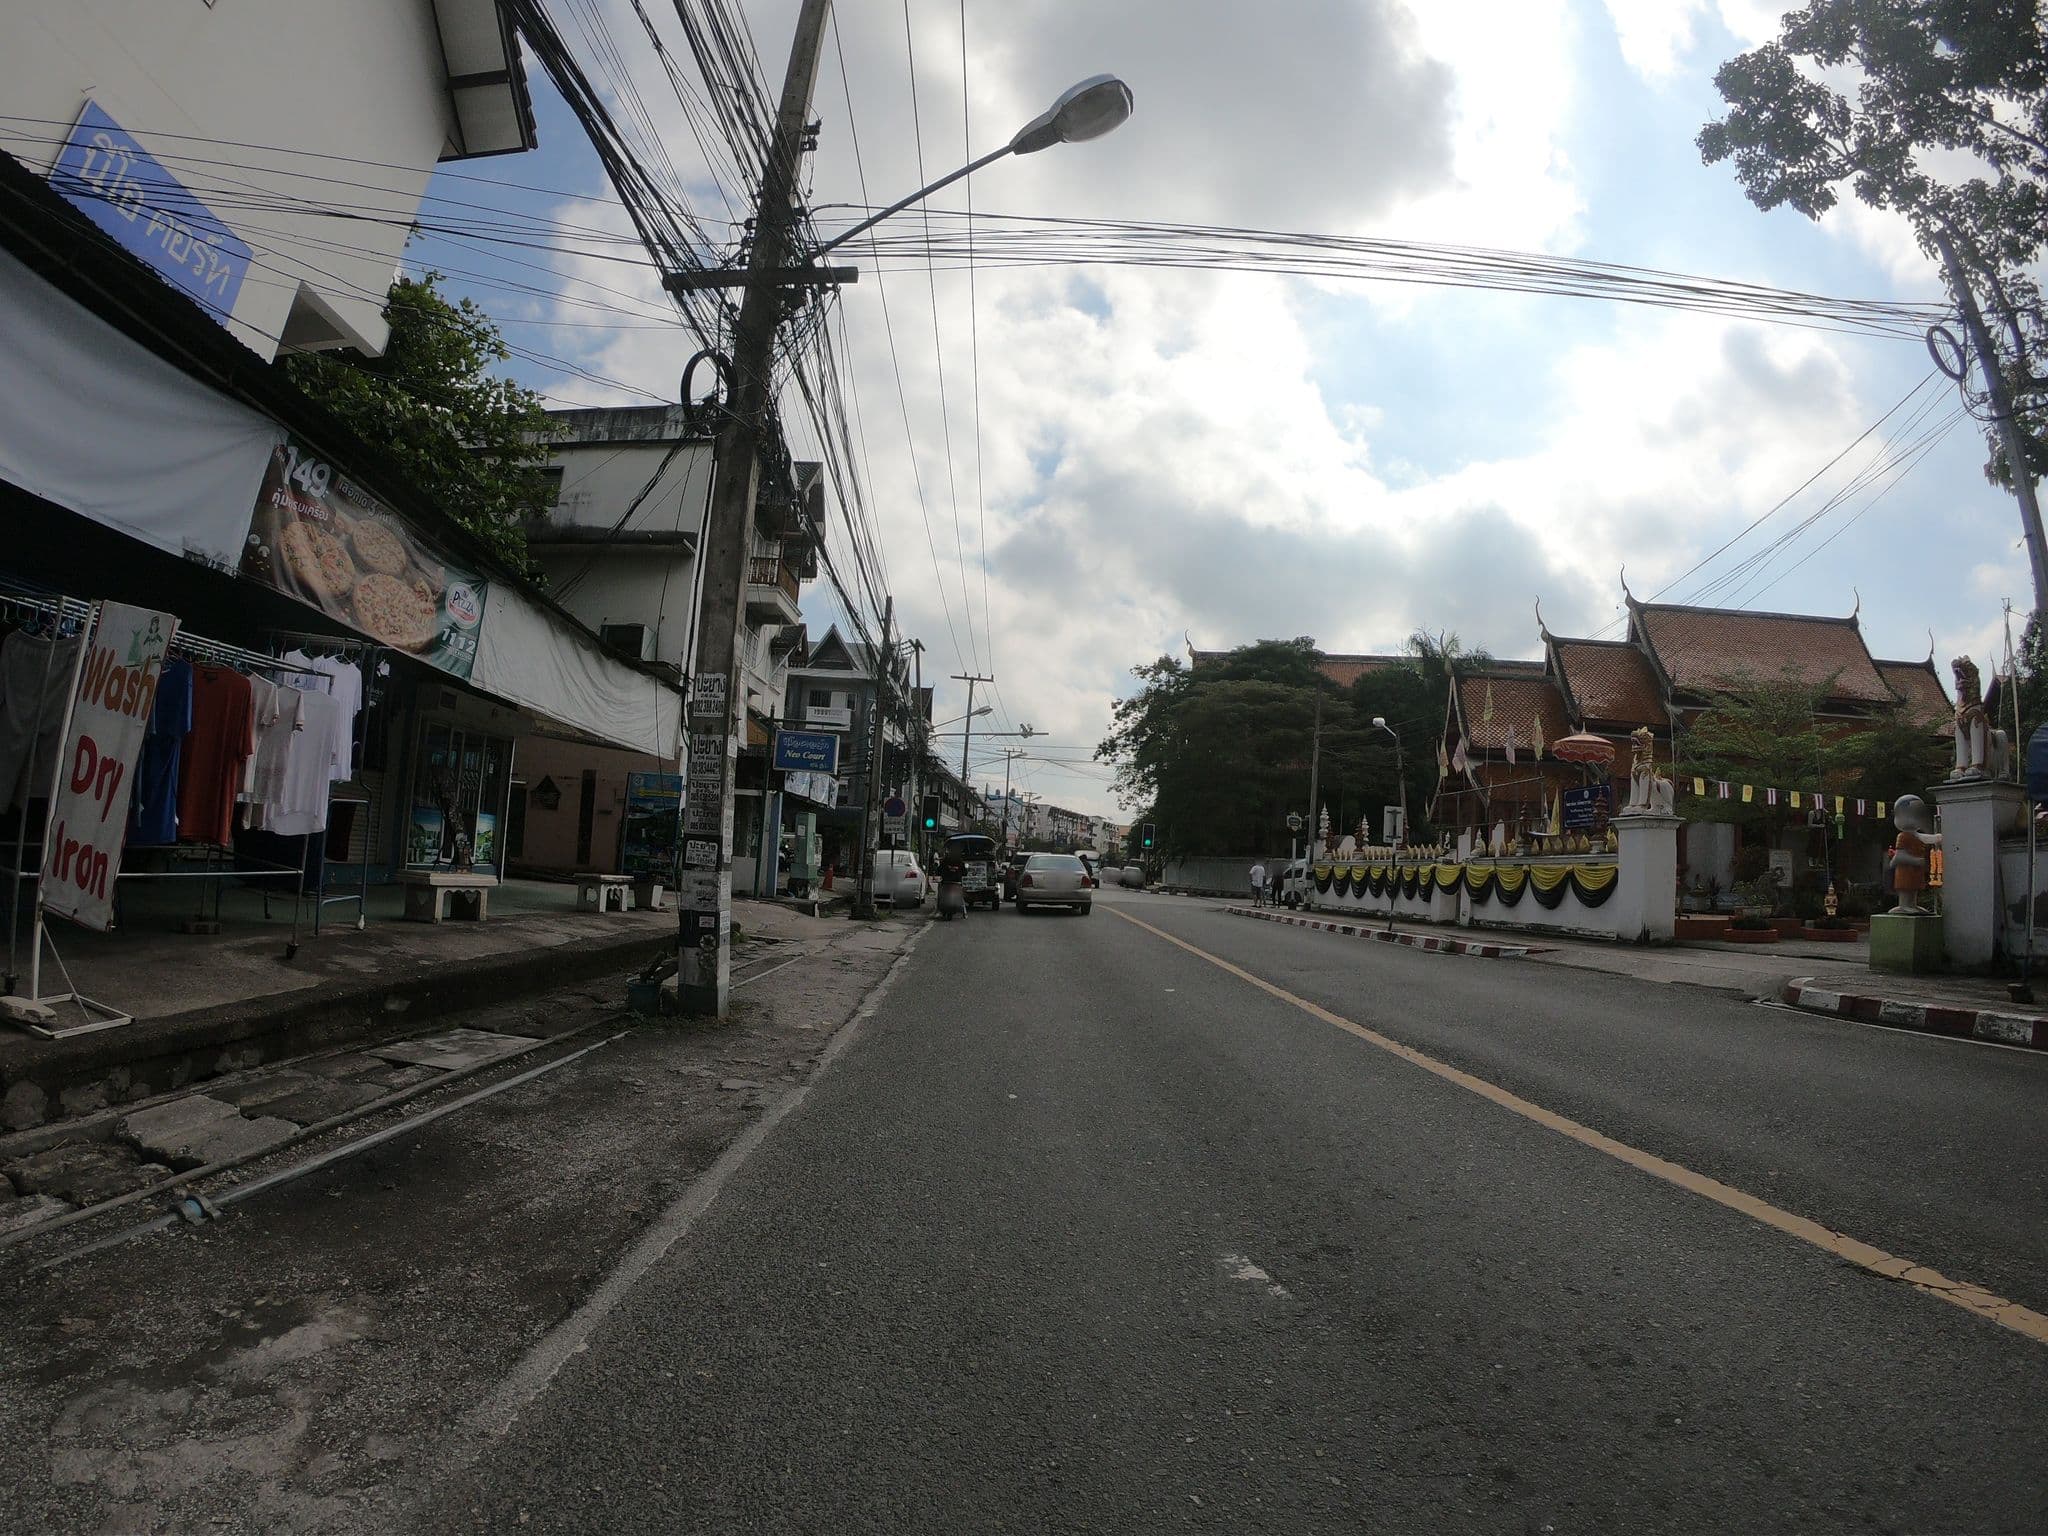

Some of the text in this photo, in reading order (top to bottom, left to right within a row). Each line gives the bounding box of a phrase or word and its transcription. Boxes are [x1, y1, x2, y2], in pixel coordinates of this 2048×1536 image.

[442, 627, 477, 656] 1112
[83, 645, 157, 721] Wash
[696, 673, 727, 693] ปะยาง
[693, 735, 723, 755] ปะยาง
[784, 749, 826, 761] Neo Court
[70, 734, 124, 822] Dry
[53, 820, 109, 900] Iron
